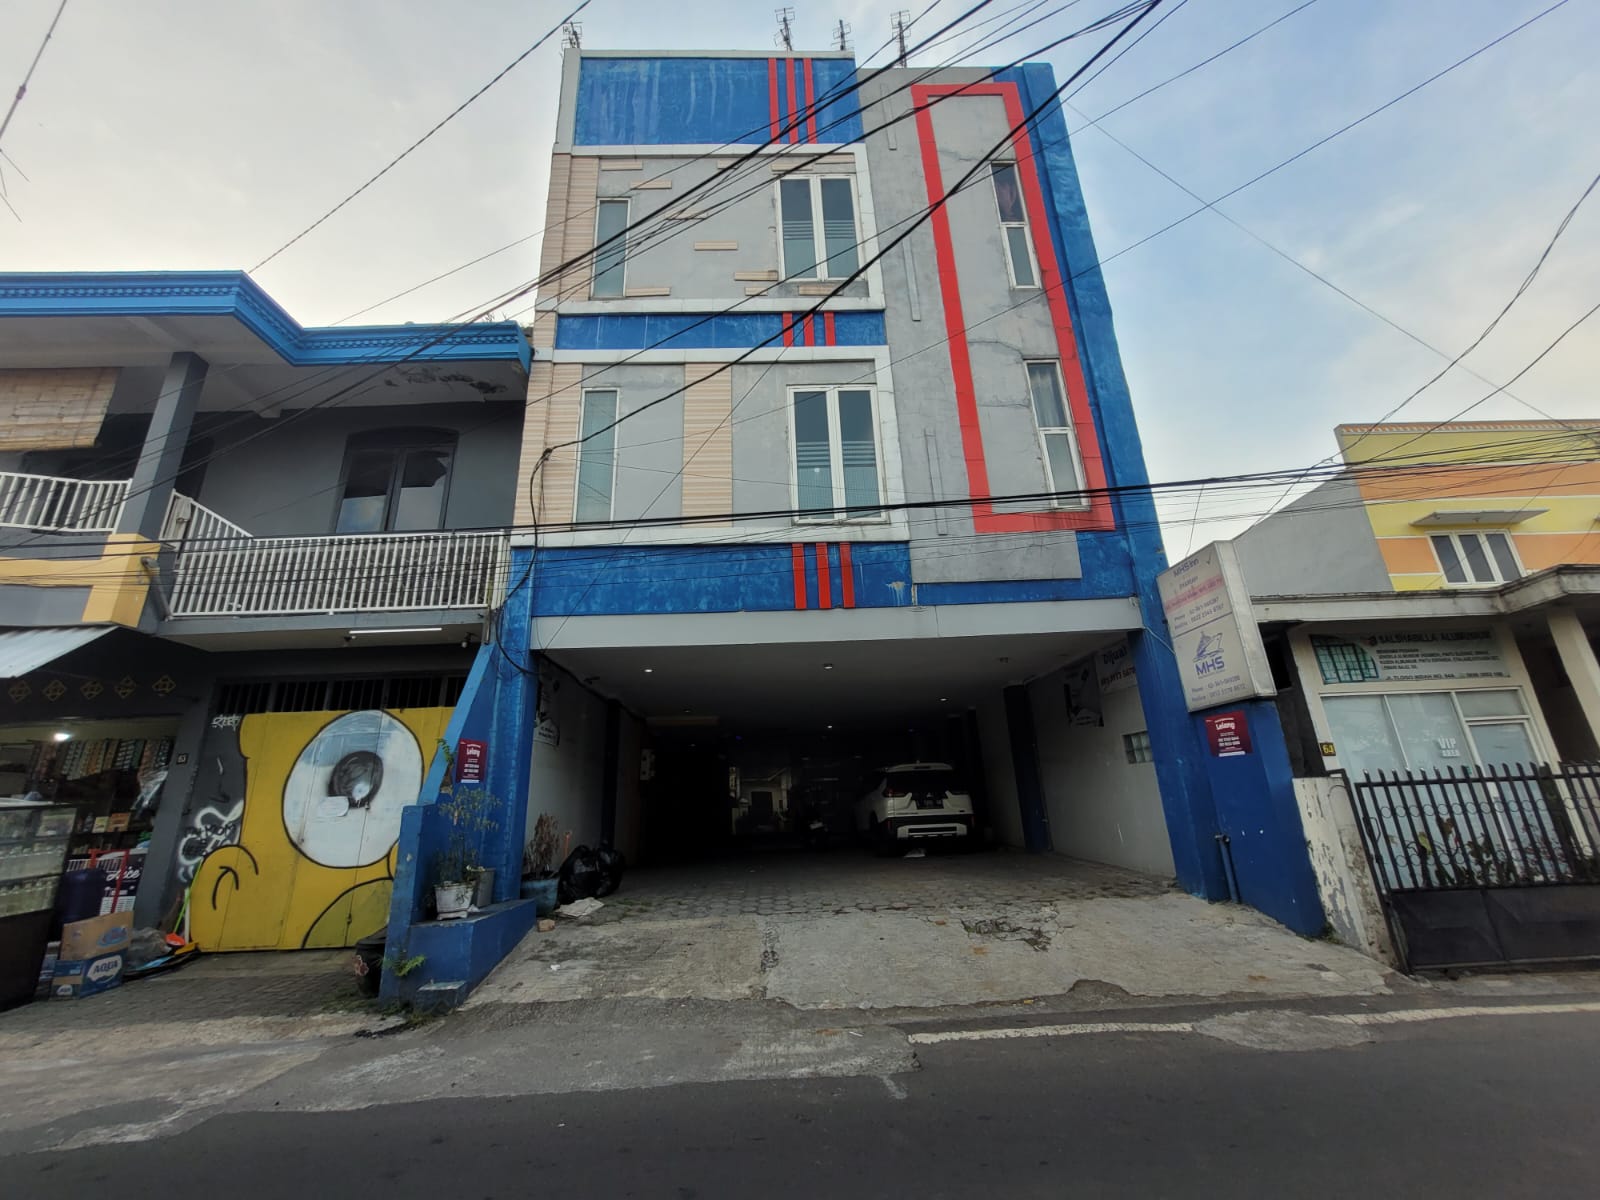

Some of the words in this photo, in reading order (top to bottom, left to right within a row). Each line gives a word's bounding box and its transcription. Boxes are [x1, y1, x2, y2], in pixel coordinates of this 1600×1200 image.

[1173, 562, 1190, 577] MHS
[1195, 656, 1225, 675] MHS
[1322, 744, 1334, 754] 64
[1438, 738, 1456, 749] VIP
[93, 960, 118, 975] AQUA
